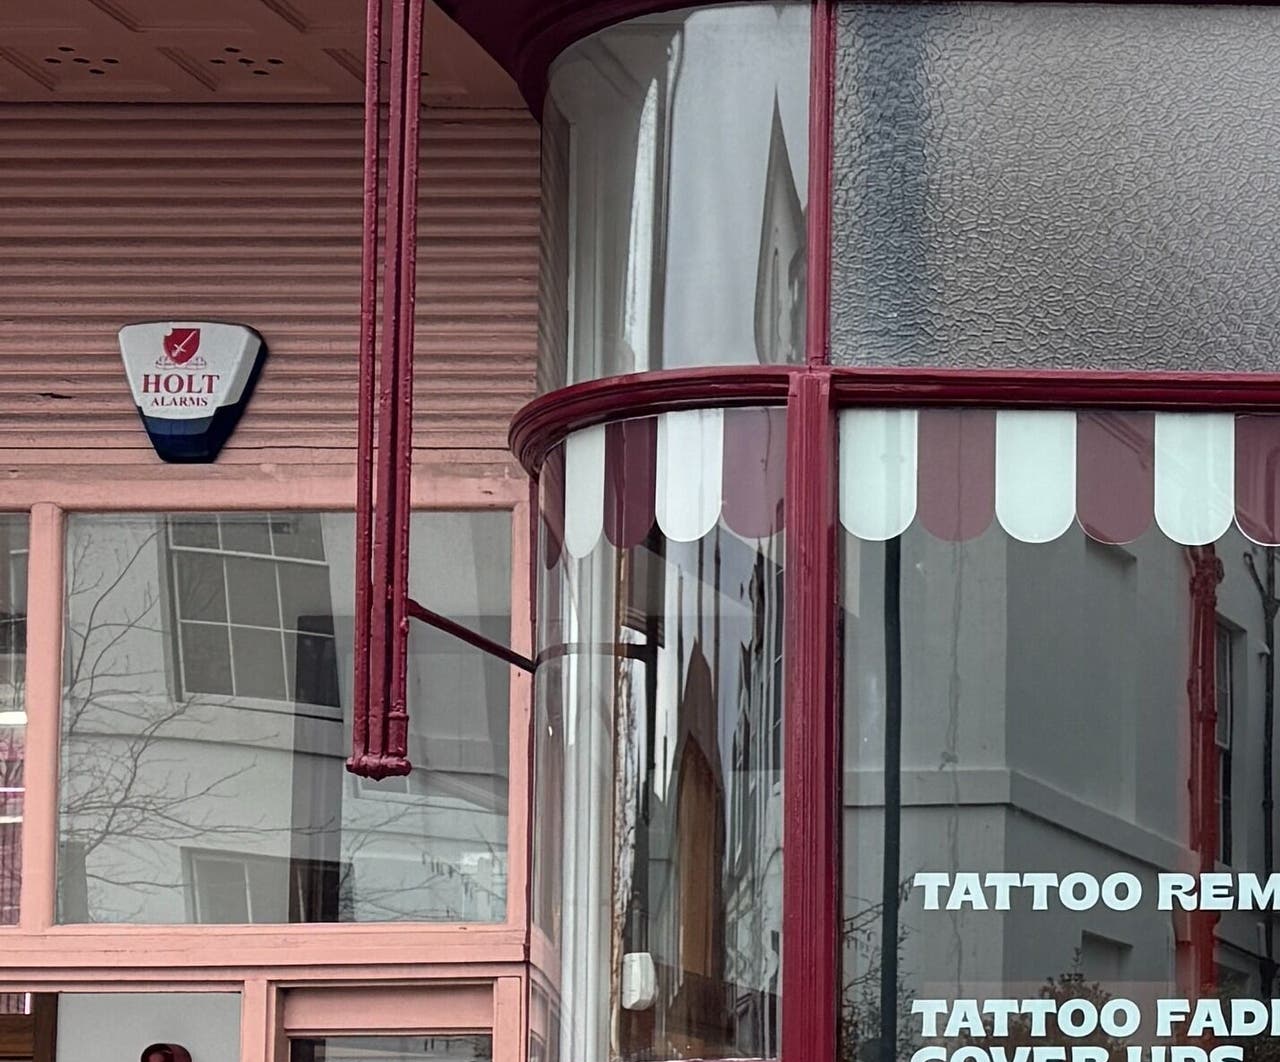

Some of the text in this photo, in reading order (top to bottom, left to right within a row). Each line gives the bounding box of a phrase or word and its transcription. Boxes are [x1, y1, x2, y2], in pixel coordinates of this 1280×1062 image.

[142, 373, 220, 394] HOLT
[151, 396, 208, 407] ALARMS
[913, 871, 1142, 911] TATTOO
[911, 998, 1141, 1038] TATTOO
